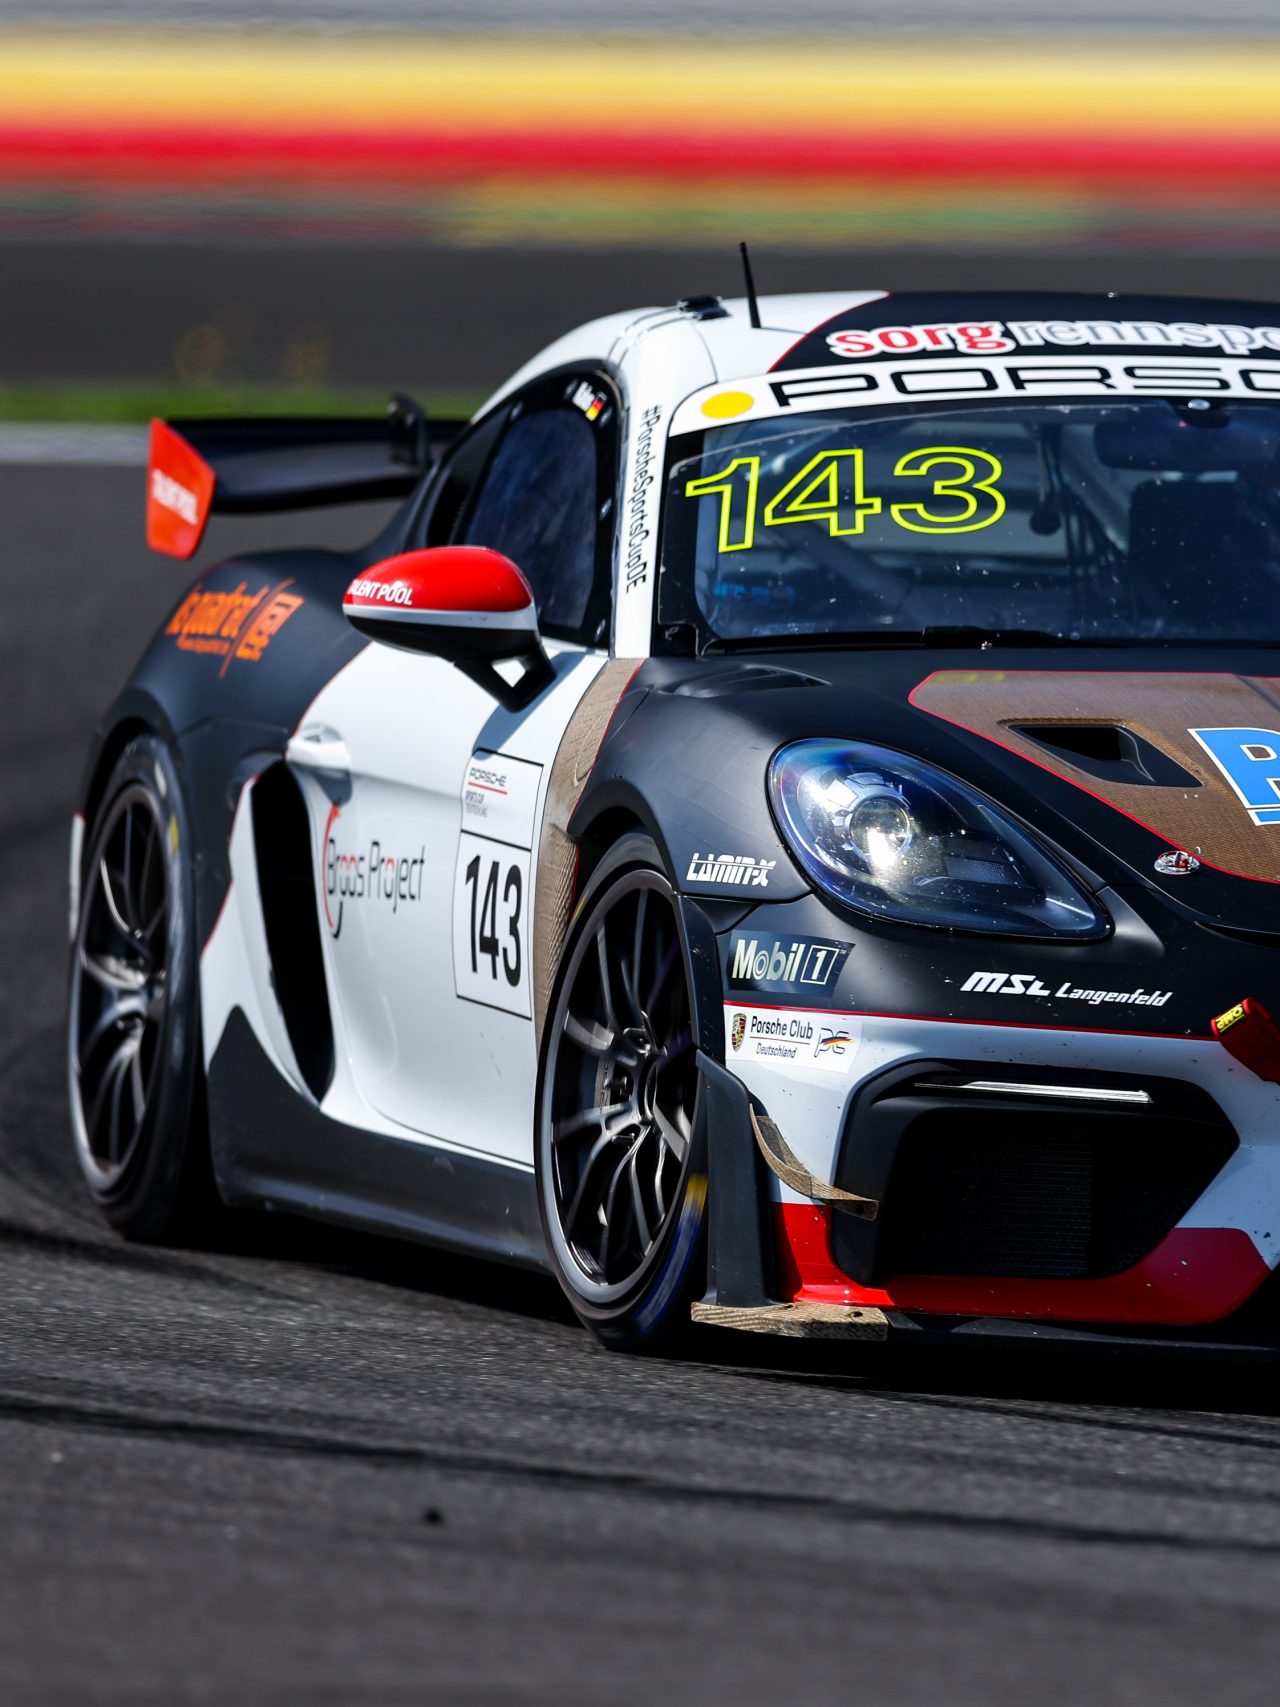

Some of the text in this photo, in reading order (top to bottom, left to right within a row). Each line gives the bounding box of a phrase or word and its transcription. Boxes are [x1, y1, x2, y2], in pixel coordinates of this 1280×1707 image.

[686, 446, 1006, 554] 143
[376, 583, 414, 605] POOL
[368, 840, 425, 914] Project
[465, 854, 522, 988] 143
[732, 939, 806, 982] Mobil
[1054, 982, 1174, 1007] Langenfeld
[750, 1015, 788, 1037] Porsche
[789, 1019, 814, 1040] Club
[755, 1042, 798, 1059] Deutschland
